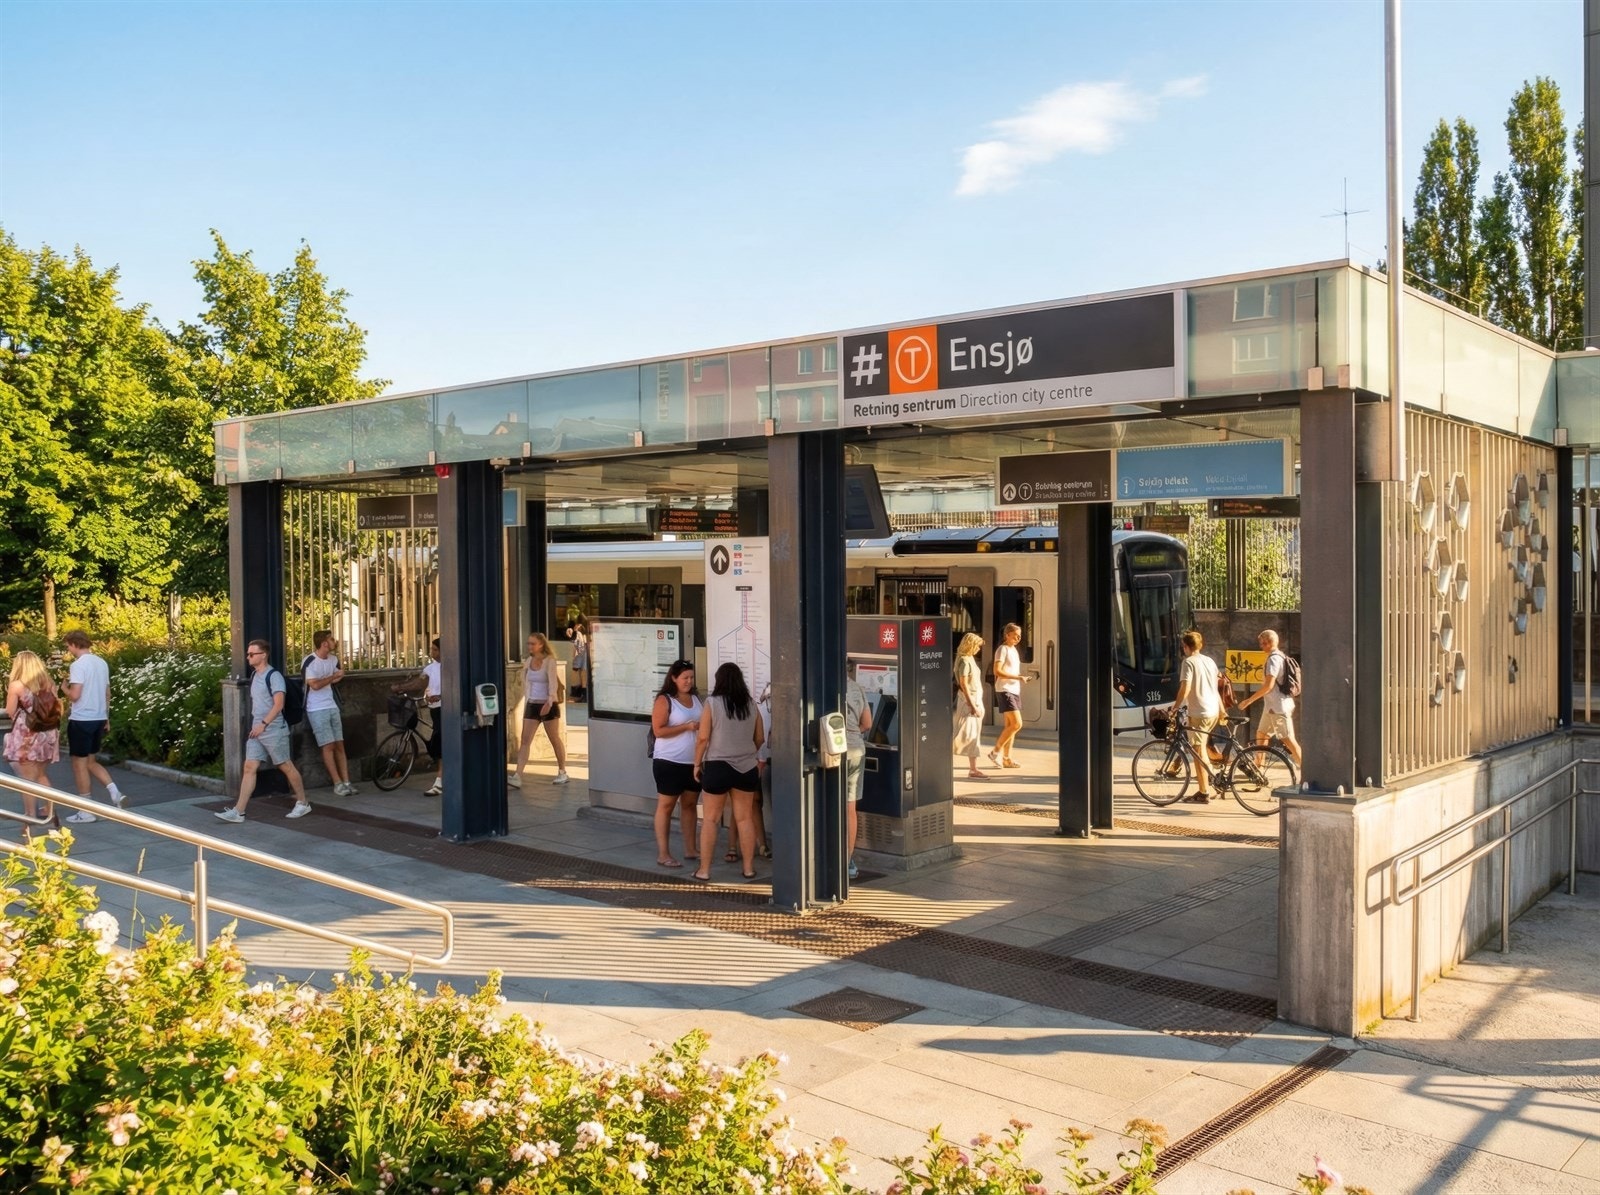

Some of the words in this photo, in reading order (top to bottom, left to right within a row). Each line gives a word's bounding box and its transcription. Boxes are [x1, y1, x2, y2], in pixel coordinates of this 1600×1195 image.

[950, 331, 1034, 375] Ensjø
[853, 402, 900, 418] Retning
[903, 398, 957, 413] sentrum
[960, 391, 1018, 408] Direction
[1022, 387, 1046, 405] city
[1049, 385, 1093, 400] centre
